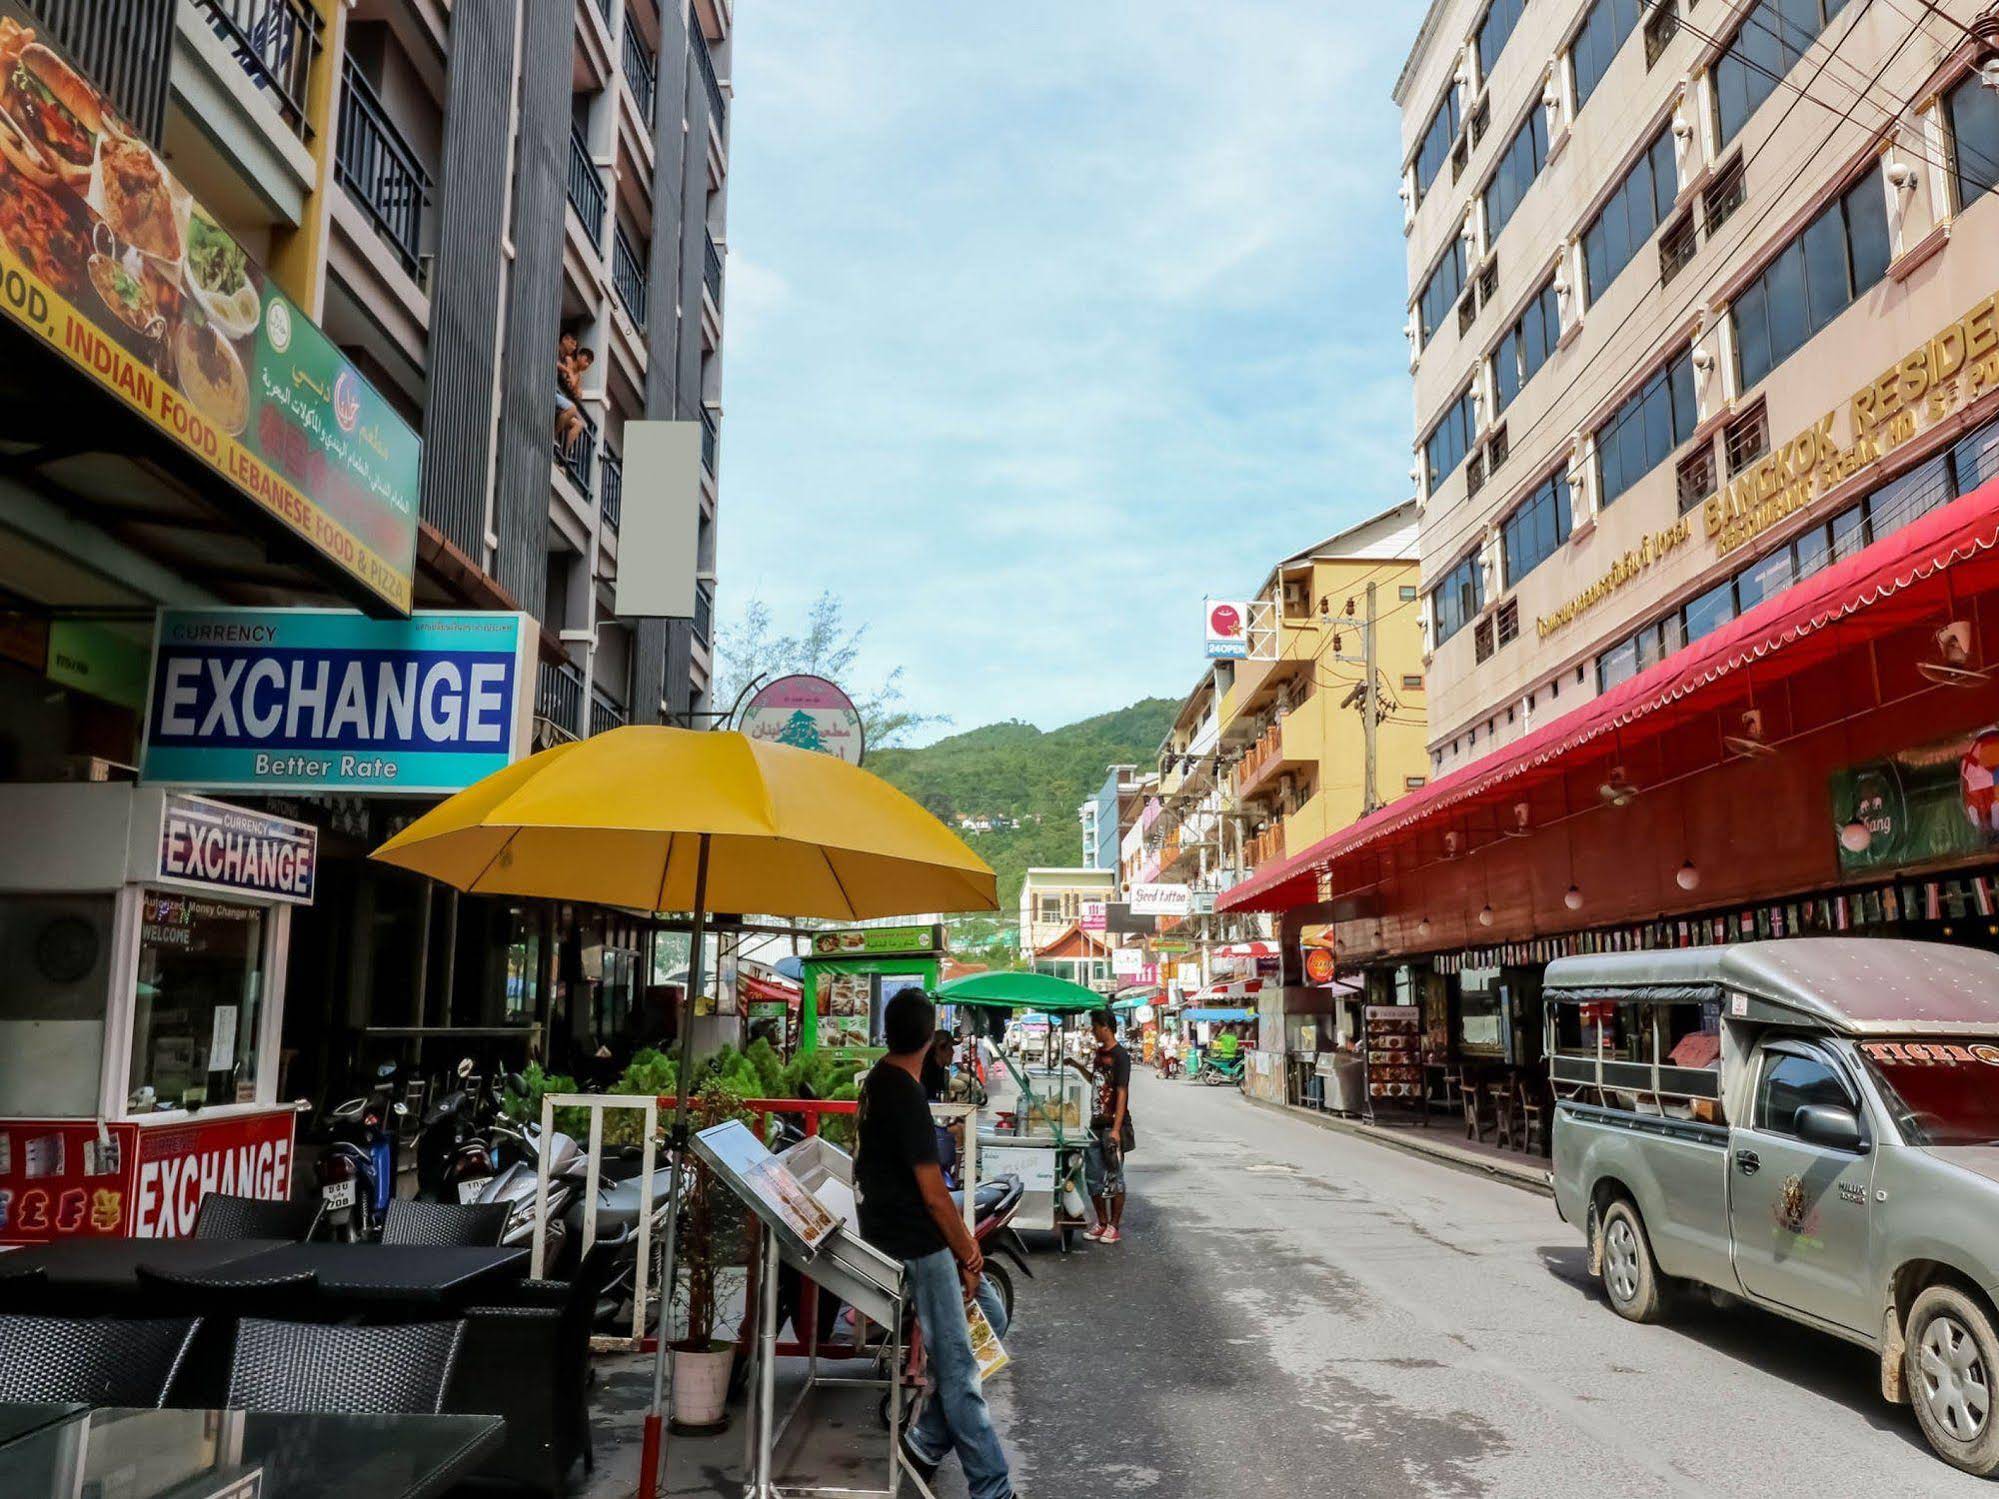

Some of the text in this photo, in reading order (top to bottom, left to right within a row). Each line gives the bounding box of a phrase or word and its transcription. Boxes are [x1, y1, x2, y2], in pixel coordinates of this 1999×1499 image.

[1703, 292, 1999, 537] BANGKOK RESIDE
[66, 315, 153, 410] INDIAN
[229, 446, 311, 531] LEBANESE
[316, 515, 354, 562] FOOD
[358, 552, 366, 574] &
[370, 559, 403, 600] PIZZA
[173, 625, 277, 642] CURRENCY
[160, 658, 506, 742] EXCHANGE
[255, 755, 398, 778] Better Rate
[223, 814, 269, 836] CURRENCY
[167, 820, 311, 893] EXCHANGE
[187, 901, 215, 915] Money
[216, 904, 247, 920] Changer
[142, 926, 191, 945] WELCOME
[1860, 1043, 1976, 1062] TIGER
[136, 1139, 289, 1238] EXCHANGE
